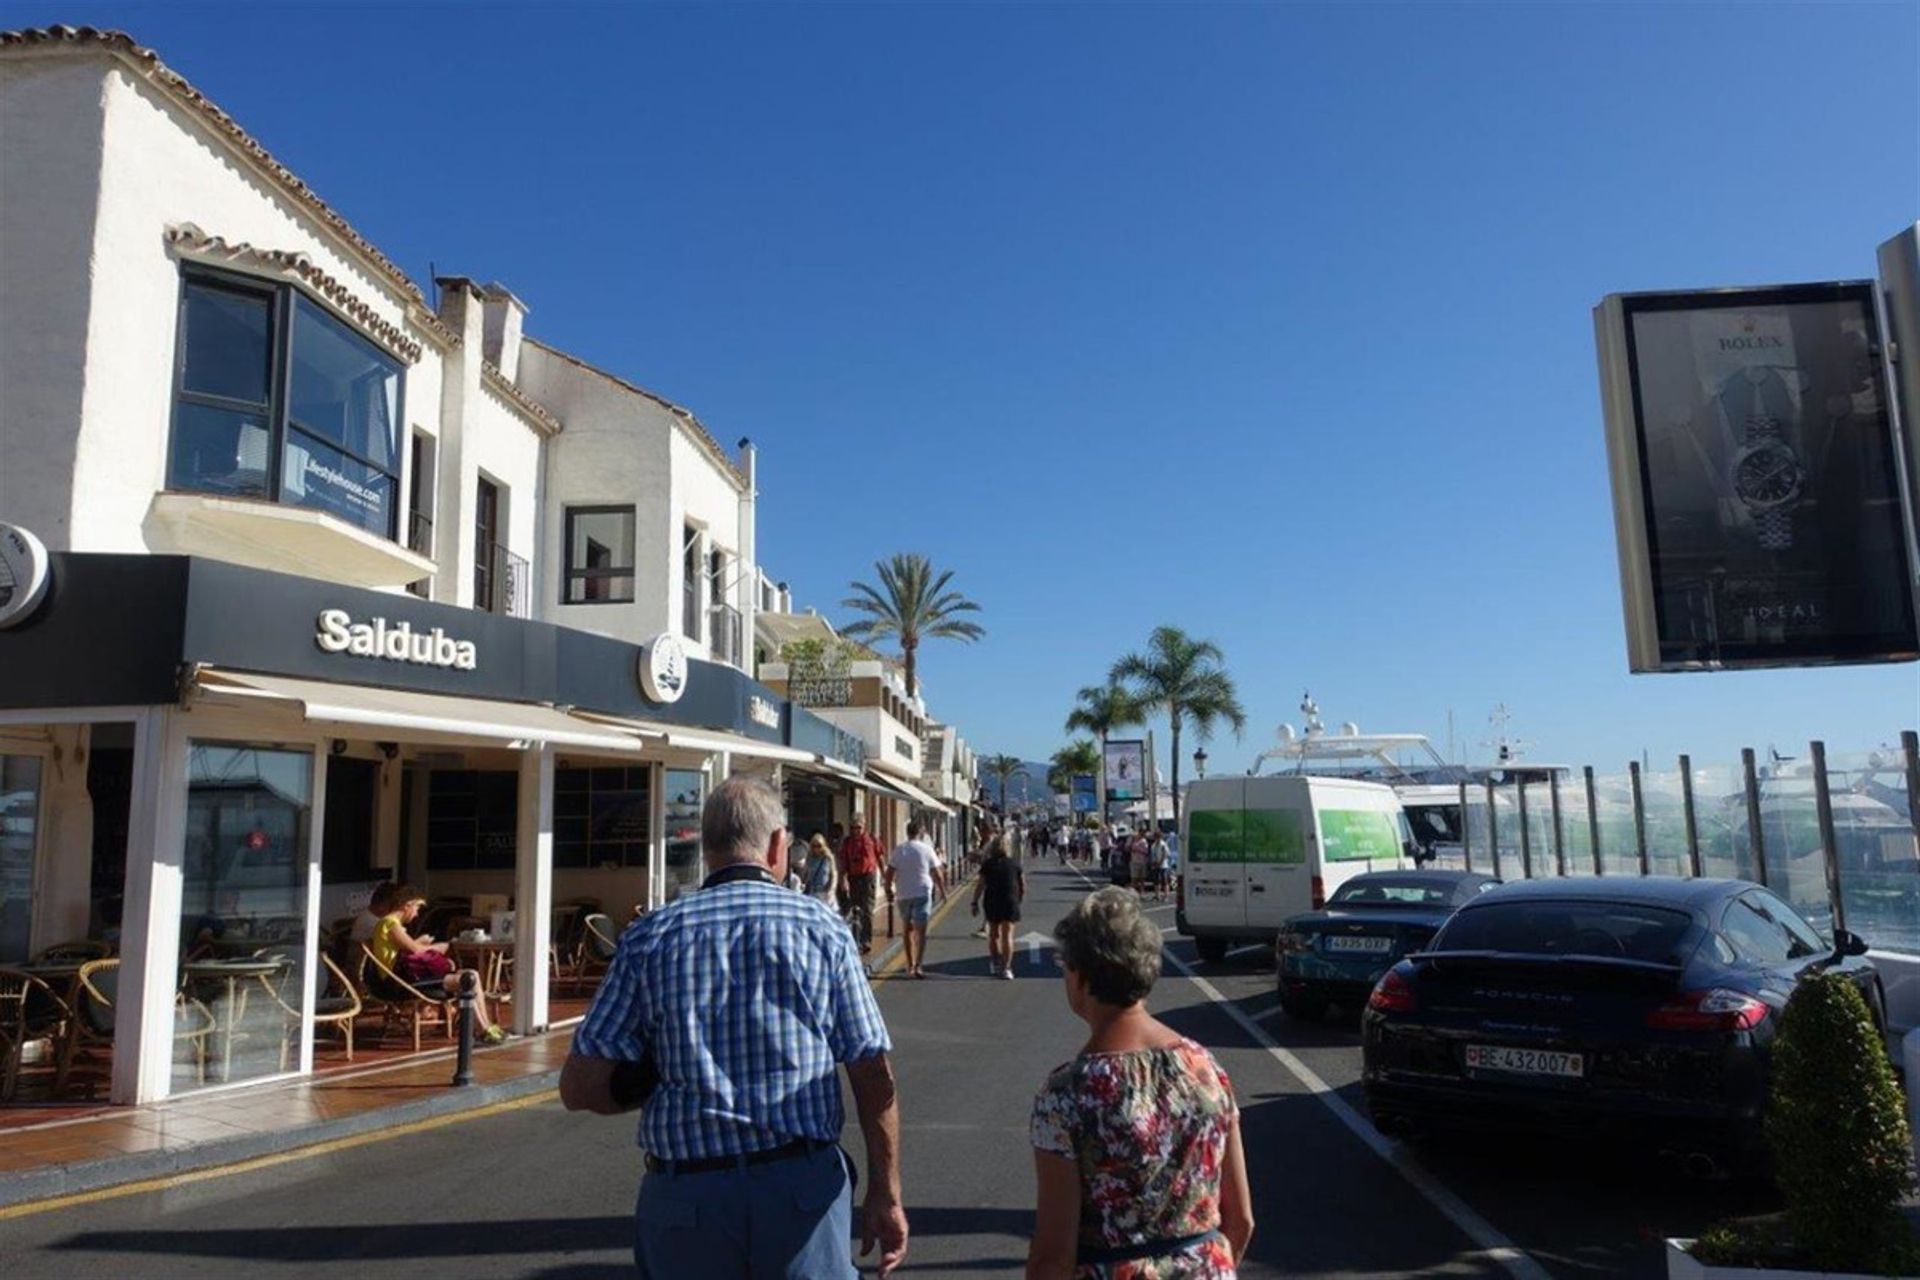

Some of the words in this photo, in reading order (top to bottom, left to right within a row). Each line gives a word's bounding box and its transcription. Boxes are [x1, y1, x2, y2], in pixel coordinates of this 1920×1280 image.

[1717, 335, 1784, 351] ROLEX
[317, 608, 477, 671] Salduba
[1473, 989, 1574, 1002] PORSCHE
